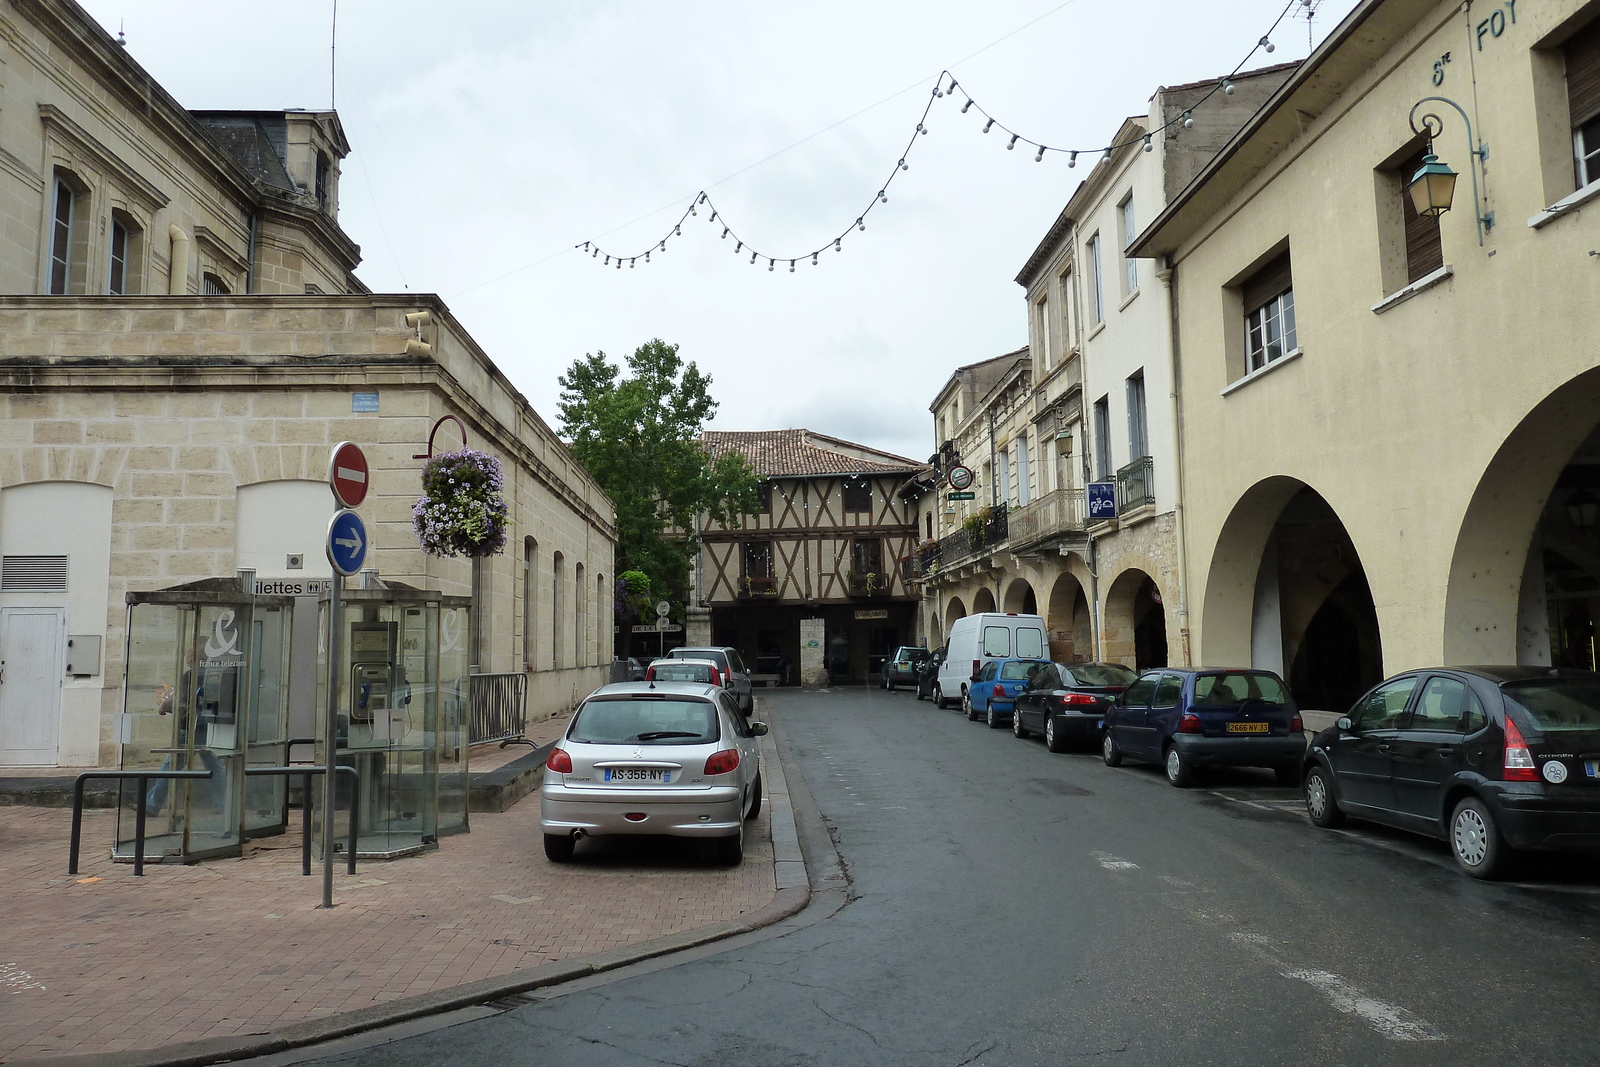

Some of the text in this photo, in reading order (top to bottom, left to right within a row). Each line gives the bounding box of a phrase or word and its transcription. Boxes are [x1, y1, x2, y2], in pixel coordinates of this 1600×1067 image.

[1477, 0, 1515, 51] FOY
[255, 581, 302, 594] ilettes
[199, 659, 219, 668] france
[1249, 724, 1258, 732] NV
[1259, 724, 1268, 732] 33
